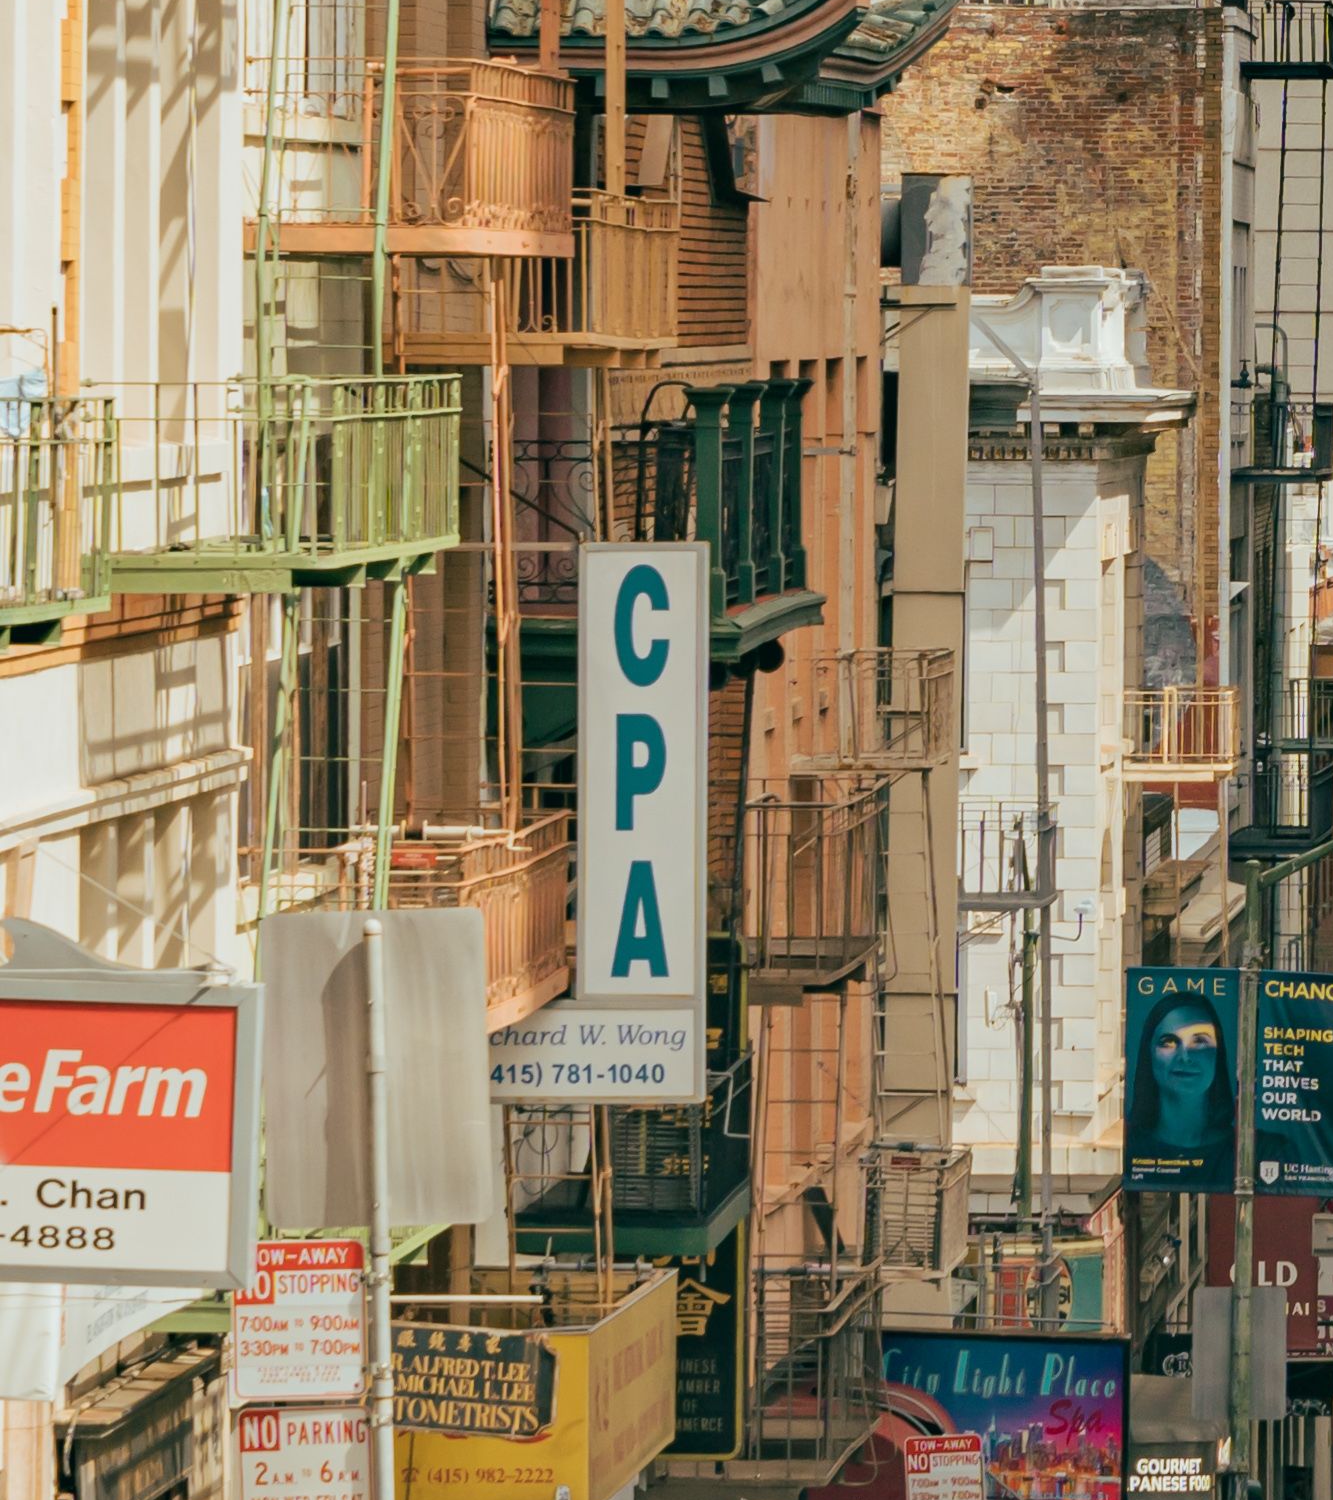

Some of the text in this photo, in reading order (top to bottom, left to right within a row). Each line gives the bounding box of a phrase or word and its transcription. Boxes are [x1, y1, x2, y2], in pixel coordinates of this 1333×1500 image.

[610, 563, 670, 977] CPA
[1138, 976, 1226, 996] GAME
[579, 1024, 687, 1052] W. Wong
[1264, 1026, 1333, 1043] SHAPING
[1264, 1043, 1304, 1057] TECH
[551, 1062, 666, 1085] 781-1040
[1263, 1059, 1304, 1073] THAT
[1262, 1076, 1319, 1091] DRIVES
[1262, 1092, 1297, 1105] OUR
[1262, 1107, 1322, 1122] WORLD
[1284, 1163, 1298, 1174] UC
[36, 1179, 147, 1211] Chan
[278, 1272, 359, 1294] STOPPING
[240, 1314, 360, 1332] 7:00AM 9:00AM
[240, 1339, 360, 1356] 3:30PM 7:00PM
[409, 1356, 480, 1378] ALFRED
[497, 1362, 531, 1382] LEE
[953, 1349, 1026, 1399] Light
[1040, 1351, 1118, 1399] Place
[502, 1379, 535, 1403] LEE
[1045, 1400, 1105, 1445] Spa
[243, 1414, 367, 1450] NO PARKING
[914, 1438, 973, 1451] TOW-AWAY
[907, 1453, 980, 1472] NO STOPPING
[1135, 1457, 1203, 1475] GOURMET
[427, 1467, 554, 1485] (415) 982-2222
